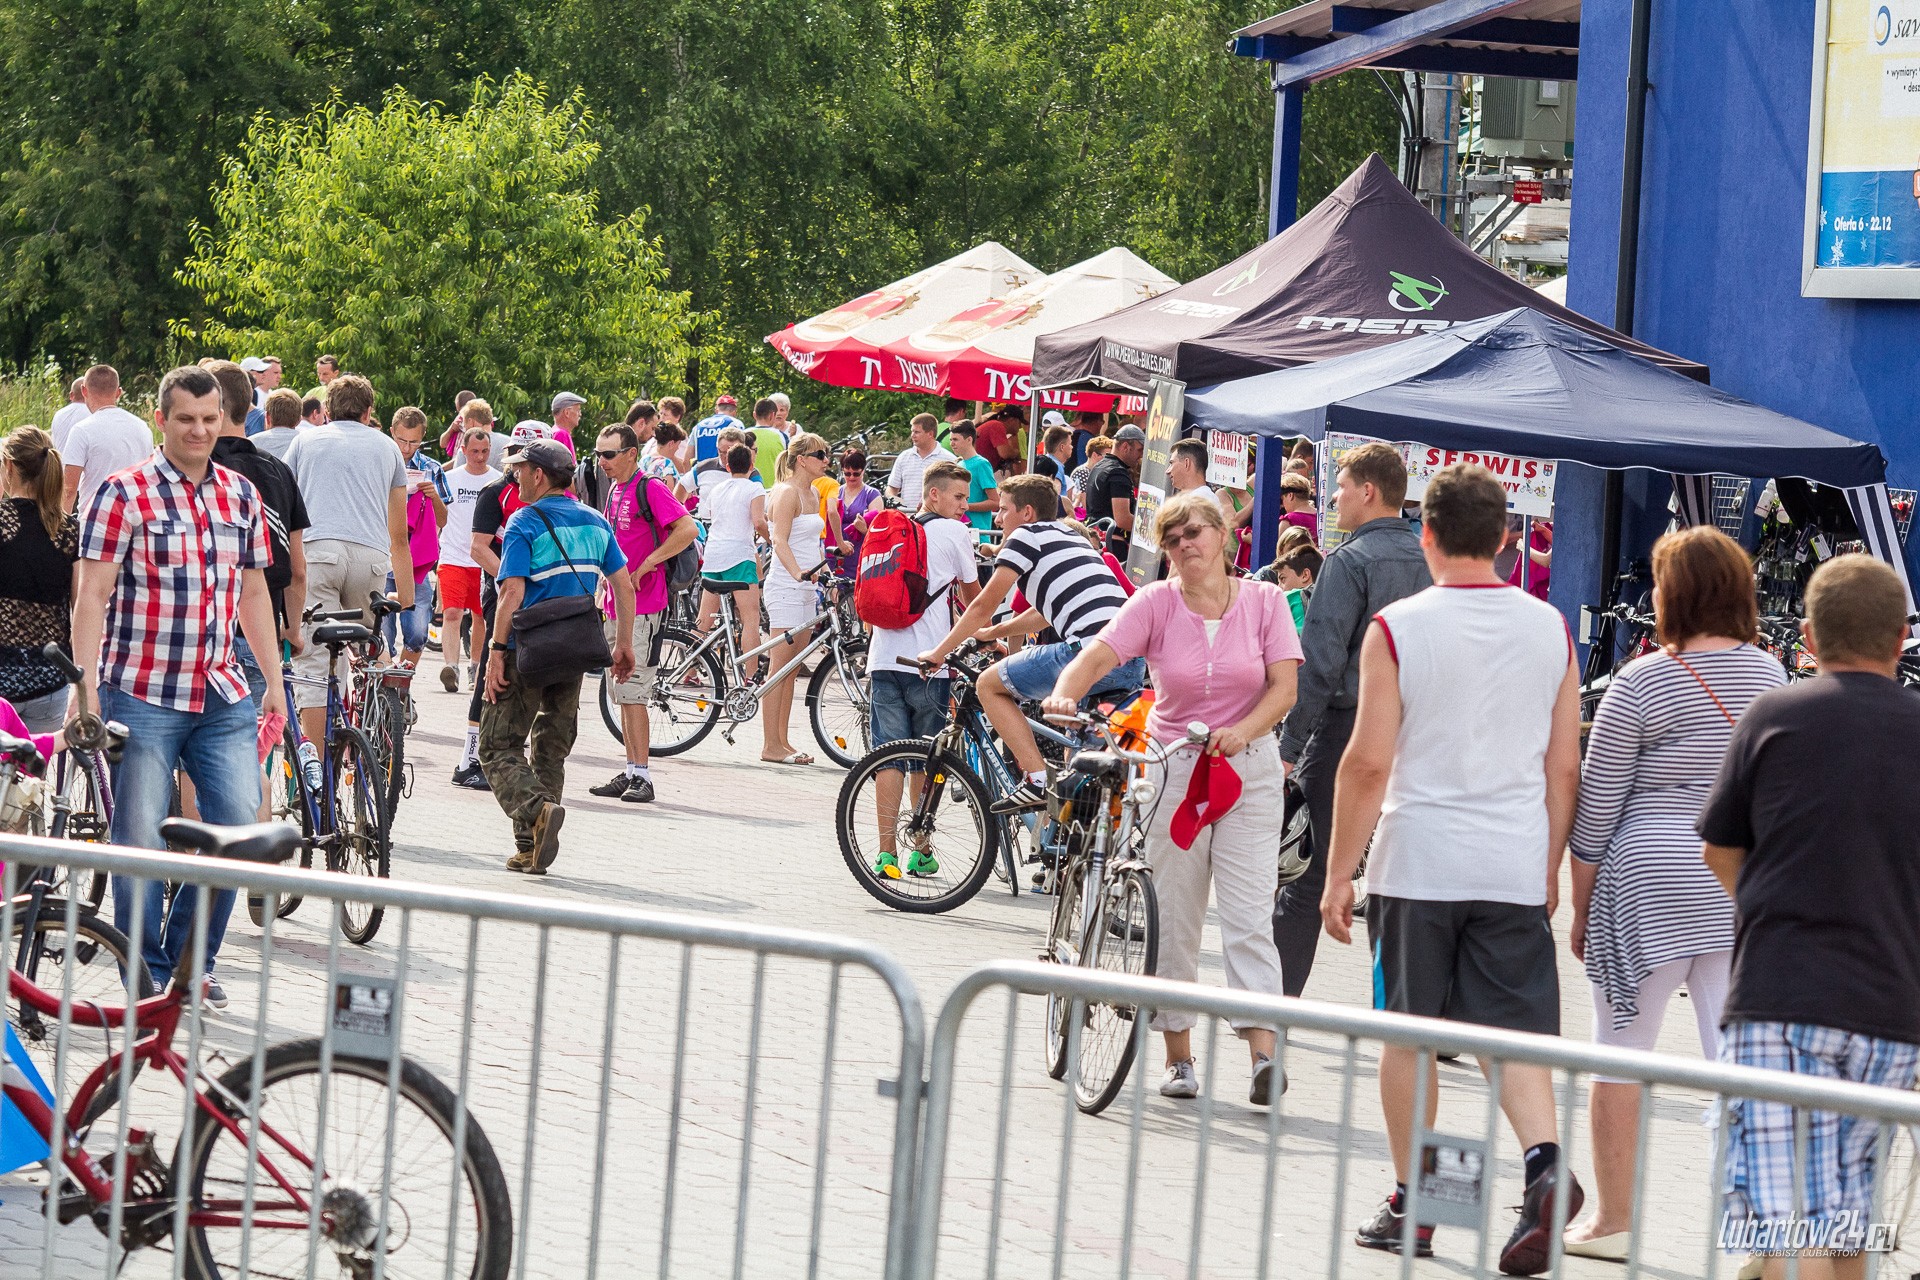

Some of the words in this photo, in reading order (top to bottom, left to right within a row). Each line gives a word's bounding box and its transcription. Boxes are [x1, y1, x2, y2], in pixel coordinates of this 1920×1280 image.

[1834, 216, 1857, 231] Oferta
[1858, 217, 1864, 231] 6
[1870, 216, 1891, 231] 22.12
[1296, 316, 1466, 335] MER
[1105, 341, 1172, 375] WWW.MERIDA-BIKES.COM
[895, 355, 938, 390] TYSKIE
[1212, 431, 1242, 453] SERWIS
[861, 543, 904, 580] NIKE
[469, 735, 478, 755] adidas
[982, 737, 1016, 794] VORTEX
